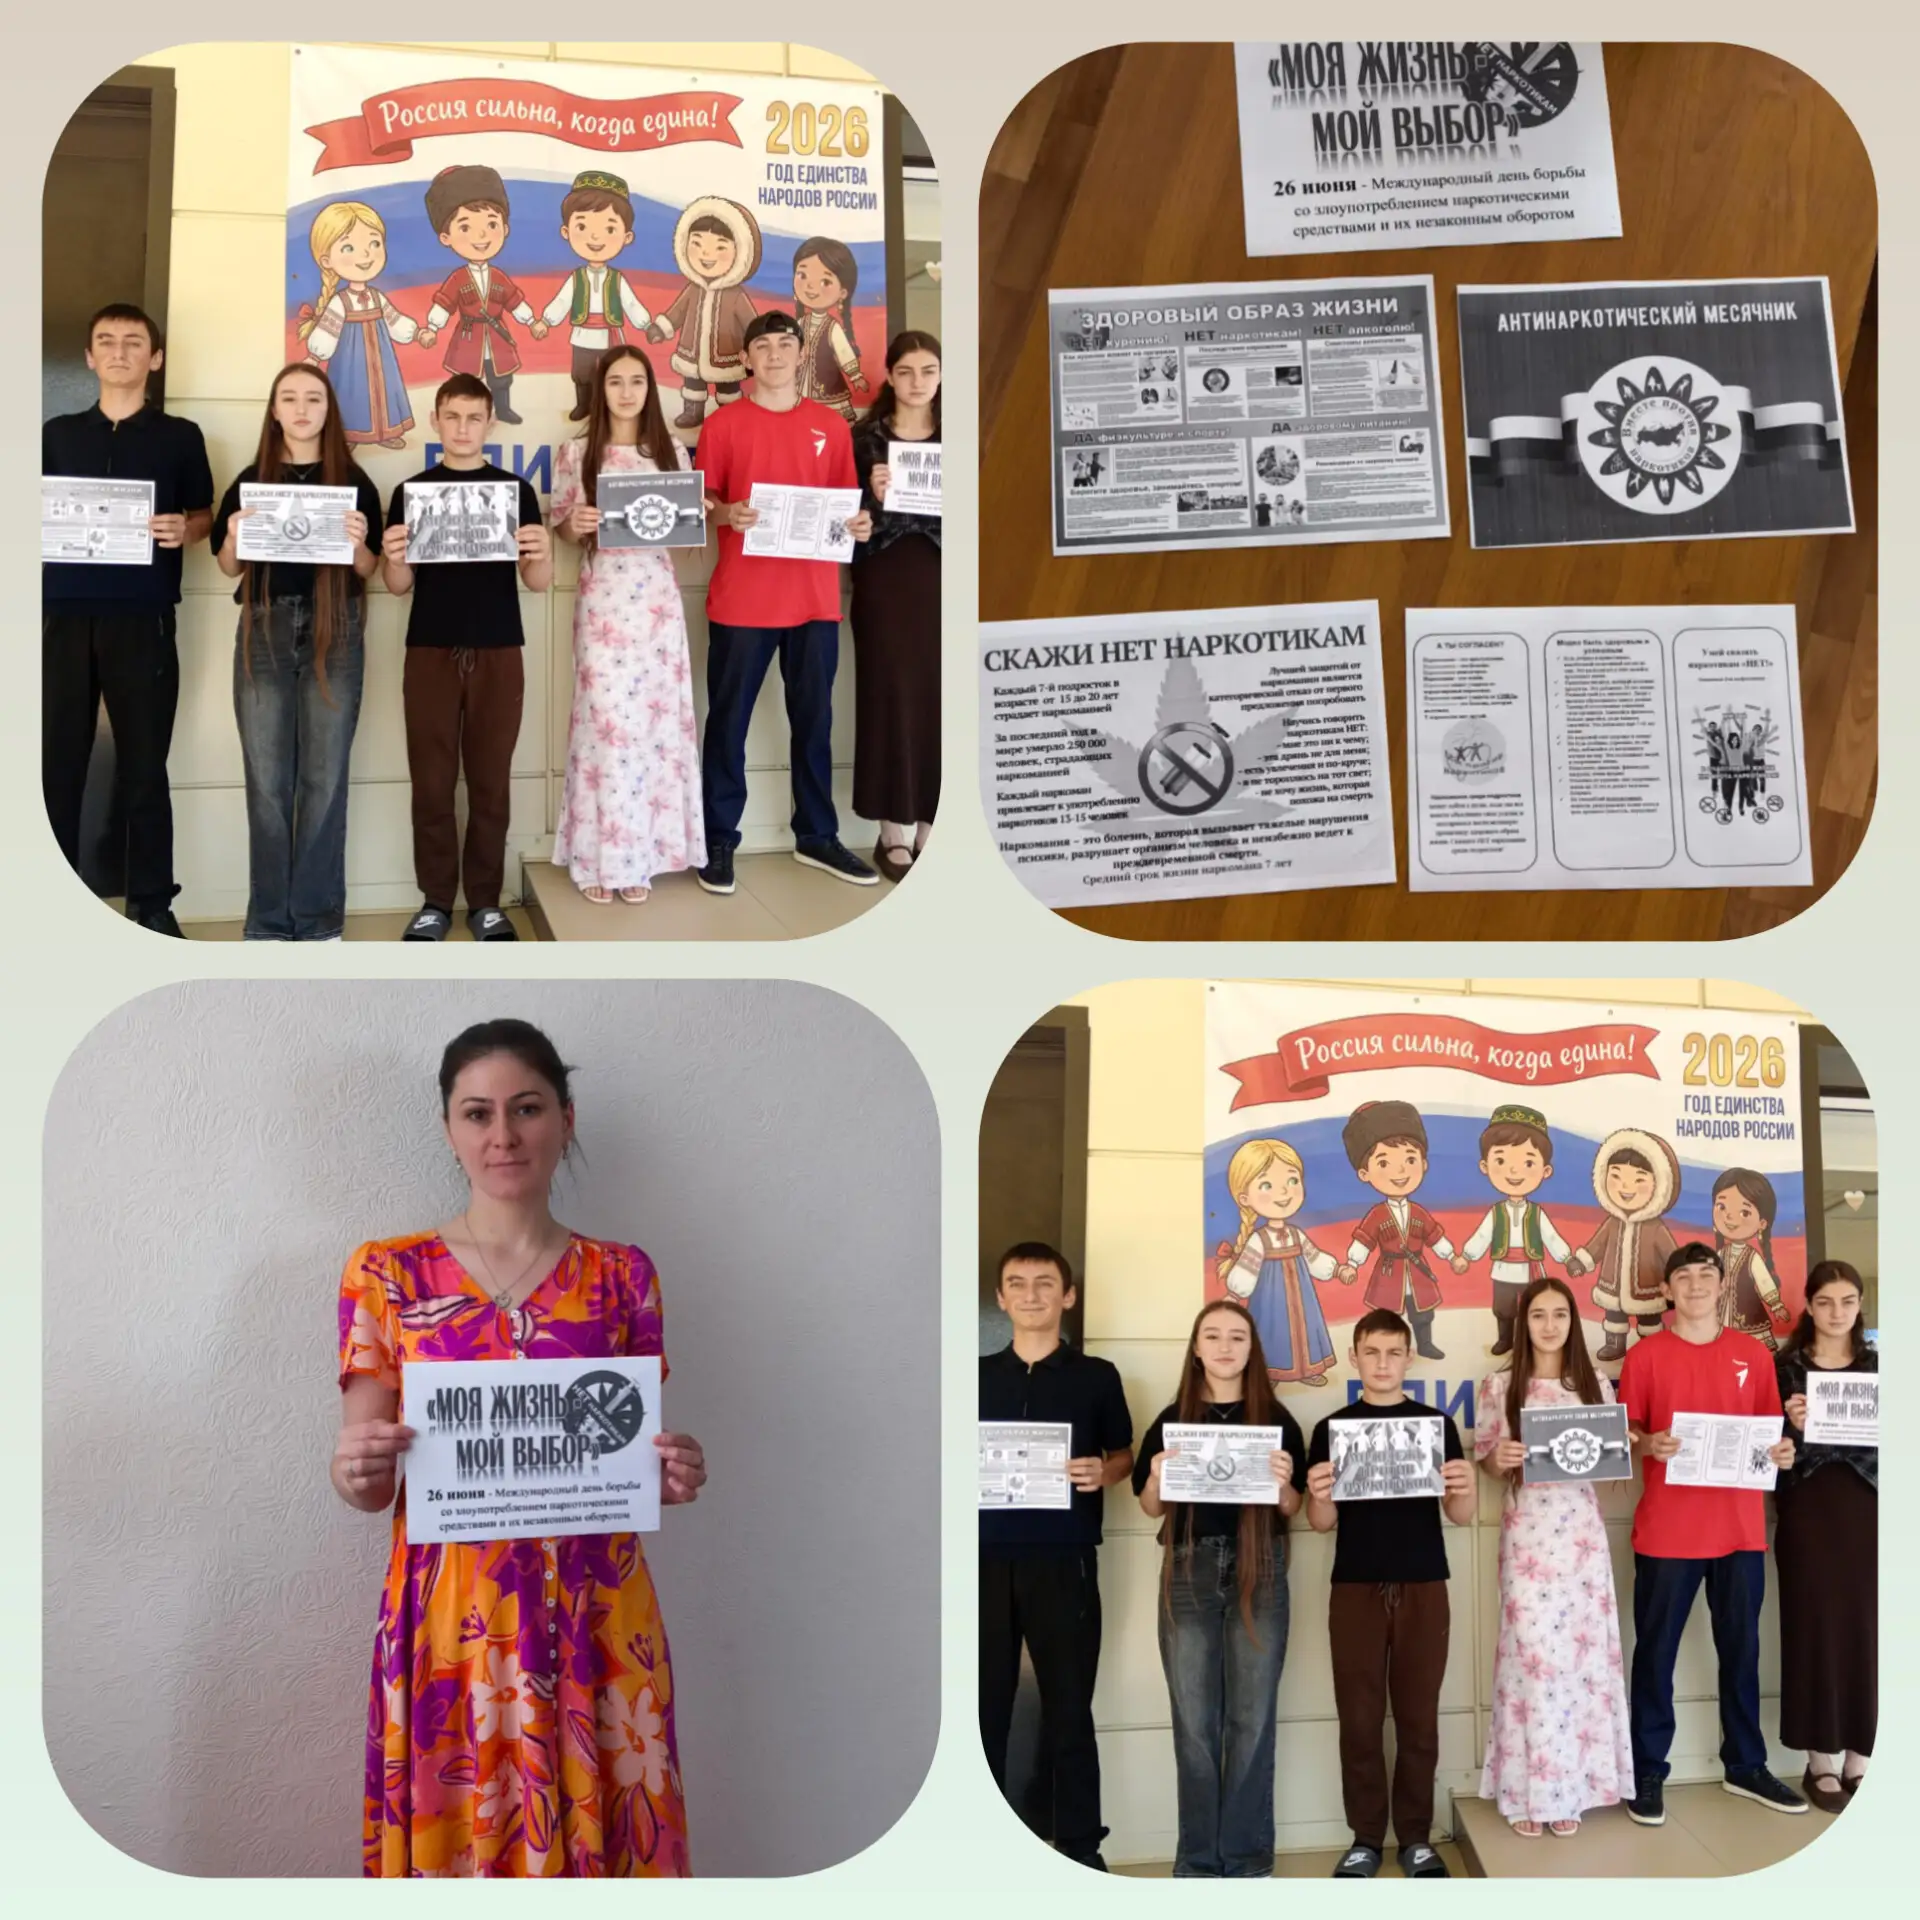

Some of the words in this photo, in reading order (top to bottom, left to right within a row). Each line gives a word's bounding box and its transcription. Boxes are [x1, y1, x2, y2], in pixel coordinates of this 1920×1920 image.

[1268, 42, 1346, 90] «МОЯ
[1357, 42, 1467, 86] ЖИЗНЬ
[1496, 59, 1558, 114] НАРКОТИКАМ
[378, 99, 468, 134] Россия
[476, 98, 563, 130] сильна,
[570, 111, 636, 146] когда
[643, 101, 719, 142] едина!
[766, 100, 869, 158] 2026
[1312, 100, 1382, 152] МОЙ
[1392, 102, 1519, 148] ВЫБОР»
[766, 162, 794, 184] ГОД
[798, 164, 868, 185] ЕДИНСТВА
[1273, 180, 1296, 196] 26
[1302, 180, 1356, 195] июня
[1371, 171, 1493, 190] Международный
[1497, 171, 1530, 183] день
[1533, 166, 1586, 182] борьбы
[758, 186, 822, 209] НАРОДОВ
[826, 189, 878, 210] РОССИИ
[1294, 206, 1311, 217] со
[1314, 197, 1448, 218] злоупотреблением
[1452, 190, 1569, 208] наркотическими
[1293, 222, 1376, 239] средствами
[1380, 221, 1389, 231] и
[1394, 220, 1411, 230] их
[1415, 214, 1502, 228] незаконным
[1506, 209, 1575, 224] оборотом
[1082, 303, 1218, 330] ЗДОРОВЫЙ
[1227, 302, 1304, 320] ОБРАЗ
[1312, 298, 1398, 317] ЖИЗНИ
[1498, 301, 1697, 332] АНТИНАРКОТИЧЕСКИЙ
[1704, 301, 1797, 324] МЕСЯЧНИК
[1185, 330, 1216, 342] НЕТ
[1220, 329, 1301, 342] наркотикам!
[1313, 324, 1343, 336] НЕТ
[1348, 323, 1415, 335] алкоголю!
[1106, 334, 1169, 348] курению!
[1272, 423, 1291, 434] ДА
[1621, 399, 1656, 437] Вместе
[1662, 399, 1697, 436] против
[1073, 433, 1094, 444] ДА
[1098, 432, 1173, 443] физкультуре
[984, 643, 1094, 672] СКАЖИ
[1100, 639, 1157, 664] НЕТ
[1163, 624, 1367, 659] НАРКОТИКАМ
[1269, 665, 1306, 677] Лучшей
[1308, 662, 1349, 674] защитой
[1350, 661, 1361, 670] от
[993, 683, 1037, 697] Каждый
[1039, 682, 1055, 693] 7-й
[1058, 680, 1111, 693] подросток
[1113, 679, 1120, 688] в
[1208, 689, 1284, 703] категорический
[1286, 688, 1311, 697] отказ
[1313, 687, 1324, 695] от
[1326, 685, 1363, 695] первого
[994, 697, 1039, 709] возрасте
[1043, 697, 1054, 706] от
[1060, 693, 1071, 704] 15
[1074, 695, 1086, 704] до
[1088, 691, 1100, 702] 20
[1102, 692, 1119, 701] лет
[994, 710, 1039, 722] страдает
[1042, 704, 1112, 718] наркоманией
[1282, 718, 1321, 728] Научись
[1323, 714, 1366, 724] говорить
[995, 733, 1007, 743] За
[1010, 729, 1068, 741] последний
[1071, 728, 1089, 738] год
[1286, 727, 1344, 738] наркотикам
[995, 746, 1023, 756] мире
[1026, 743, 1065, 755] умерло
[1067, 740, 1086, 750] 250
[1087, 738, 1107, 748] 000
[996, 758, 1042, 768] человек,
[1044, 752, 1112, 766] страдающих
[996, 767, 1070, 782] наркоманией
[996, 789, 1039, 801] Каждый
[1041, 787, 1092, 799] наркоман
[1000, 839, 1070, 853] Наркомания
[1083, 836, 1101, 845] это
[1104, 832, 1152, 844] болезнь,
[1154, 827, 1199, 839] которая
[1201, 823, 1256, 835] вызывает
[1258, 818, 1305, 830] тяжелые
[1308, 813, 1369, 828] нарушения
[1018, 852, 1069, 865] психики,
[1071, 848, 1129, 862] разрушает
[1133, 841, 1187, 856] организм
[1188, 837, 1239, 850] человека
[1242, 836, 1249, 845] и
[1252, 829, 1312, 844] неизбежно
[1314, 829, 1344, 840] ведет
[1346, 827, 1354, 836] к
[1113, 851, 1216, 870] преждевременной
[1218, 848, 1263, 861] смерти.
[1083, 873, 1131, 887] Средний
[1134, 872, 1160, 883] срок
[1162, 867, 1199, 879] жизни
[1201, 861, 1263, 876] наркомана
[1274, 859, 1293, 869] лет
[1295, 1034, 1384, 1070] Россия
[1392, 1034, 1480, 1064] сильна,
[1488, 1045, 1552, 1081] когда
[1560, 1034, 1636, 1074] едина!
[1682, 1032, 1786, 1088] 2026
[1684, 1094, 1712, 1115] ГОД
[1715, 1095, 1785, 1116] ЕДИНСТВА
[1676, 1118, 1740, 1140] НАРОДОВ
[1744, 1121, 1795, 1140] РОССИИ
[427, 1387, 482, 1423] «МОЯ
[490, 1384, 569, 1420] ЖИЗНЬ
[572, 1384, 591, 1403] НЕТ
[456, 1432, 504, 1470] МОЙ
[513, 1434, 600, 1467] ВЫБОР»
[427, 1489, 443, 1502] 26
[447, 1489, 485, 1501] июня
[495, 1484, 579, 1501] Международный
[581, 1484, 603, 1494] день
[606, 1481, 641, 1493] борьбы
[440, 1508, 452, 1517] со
[455, 1500, 548, 1517] злоупотреблением
[549, 1498, 629, 1513] наркотическими
[439, 1520, 497, 1532] средствами
[499, 1520, 506, 1528] и
[508, 1518, 520, 1527] их
[523, 1515, 582, 1527] незаконным
[584, 1511, 630, 1524] оборотом
